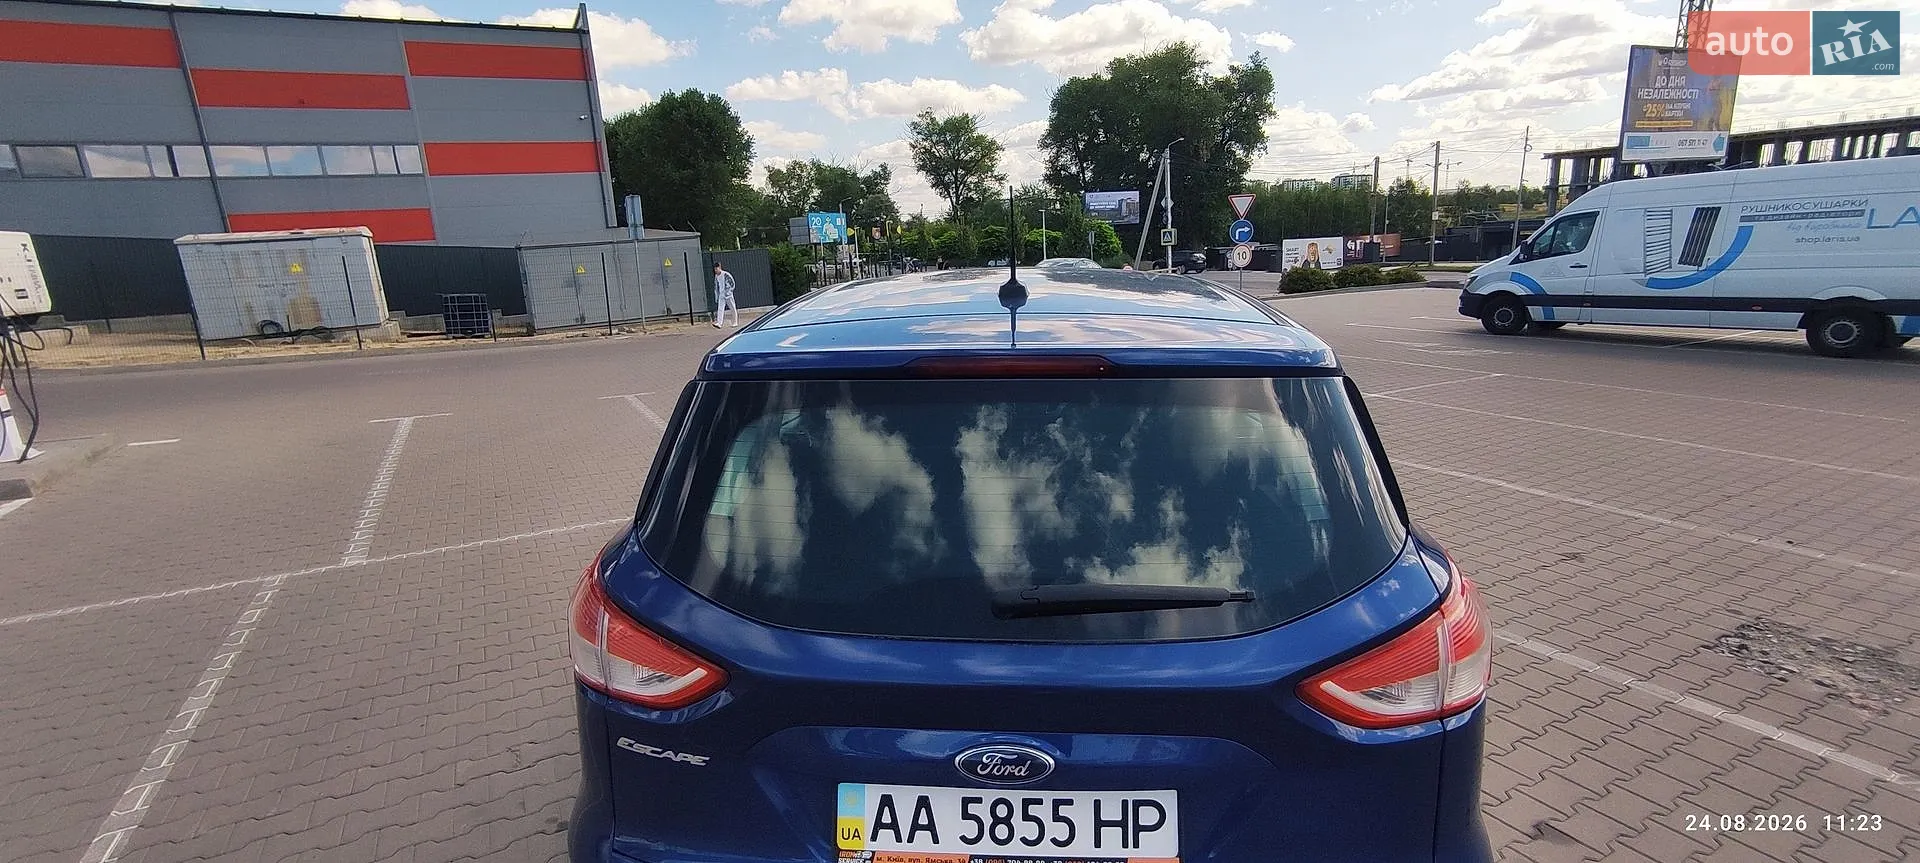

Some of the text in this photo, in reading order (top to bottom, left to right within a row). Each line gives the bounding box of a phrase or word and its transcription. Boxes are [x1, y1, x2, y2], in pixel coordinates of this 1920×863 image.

[1655, 76, 1685, 88] ДО ДНЯ
[1637, 88, 1699, 99] НЕЗАЛЕЖНОСТІ
[1741, 199, 1868, 213] РУШНИКОСУШАРКИ
[1237, 251, 1247, 261] 10
[617, 737, 710, 766] ESCAPE
[977, 754, 1029, 777] Ford
[870, 794, 1167, 849] AA 5855 HP
[841, 828, 862, 841] UA
